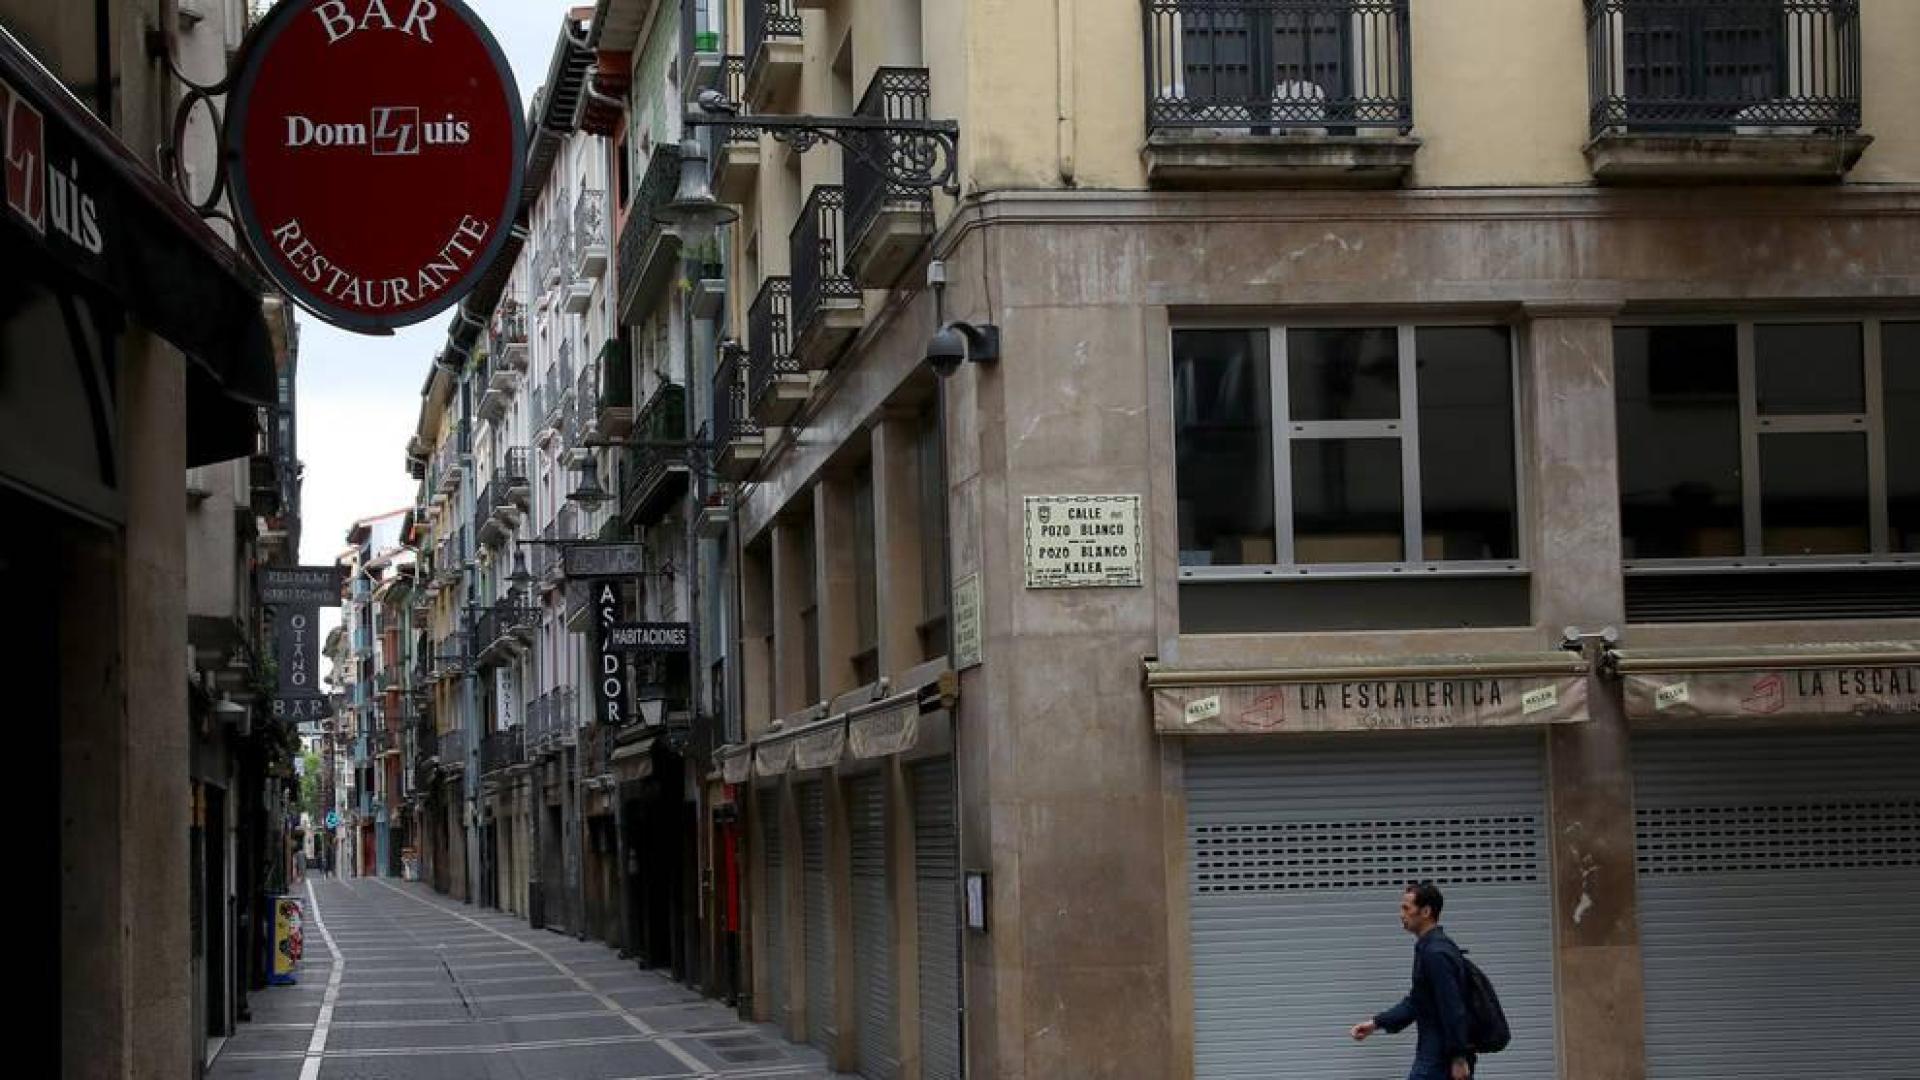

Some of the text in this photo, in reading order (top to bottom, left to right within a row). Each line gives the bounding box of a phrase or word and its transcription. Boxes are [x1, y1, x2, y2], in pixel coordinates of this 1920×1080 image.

[312, 0, 437, 45] BAR
[285, 115, 367, 146] Dom
[272, 214, 489, 307] RESTAURANTE
[1068, 507, 1102, 520] CALLE
[1041, 523, 1124, 537] POZO BLANCO
[1039, 544, 1128, 559] POZO BLANCO
[1064, 561, 1102, 573] KALEA
[612, 628, 687, 645] HABITACIONES
[1798, 669, 1919, 697] LA ESCAL
[1300, 680, 1502, 711] LA ESCALERICA
